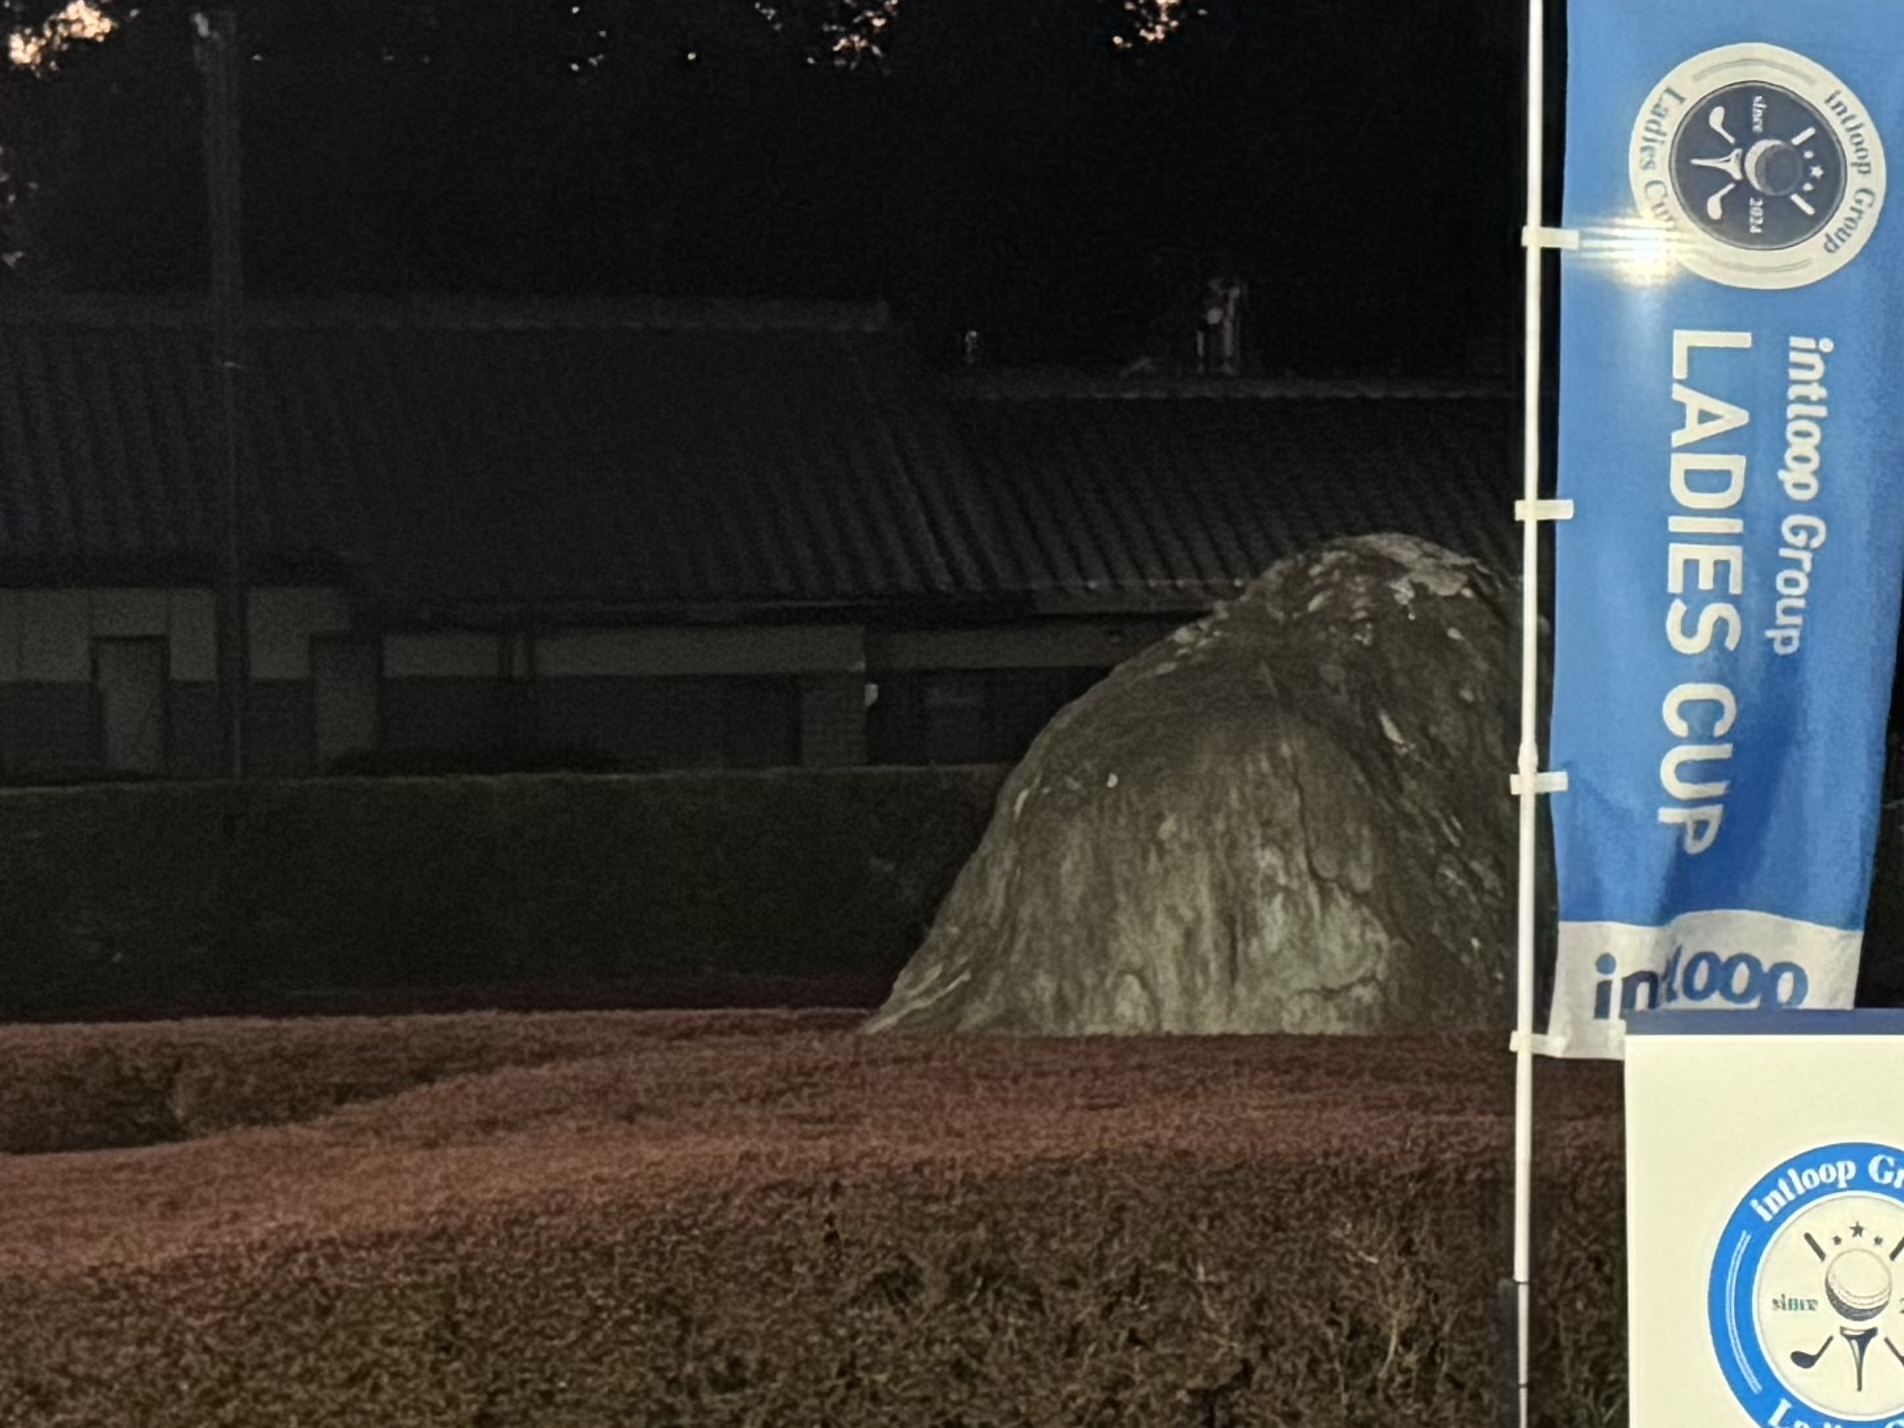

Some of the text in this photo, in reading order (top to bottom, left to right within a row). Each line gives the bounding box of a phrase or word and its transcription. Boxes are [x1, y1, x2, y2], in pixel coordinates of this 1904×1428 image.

[1640, 87, 1687, 170] Ladies
[1823, 187, 1876, 254] Group
[1765, 336, 1834, 654] intloop Group
[1657, 330, 1753, 852] LADIES CUP
[1593, 953, 1808, 1019] inloop
[1750, 1159, 1856, 1222] intloop
